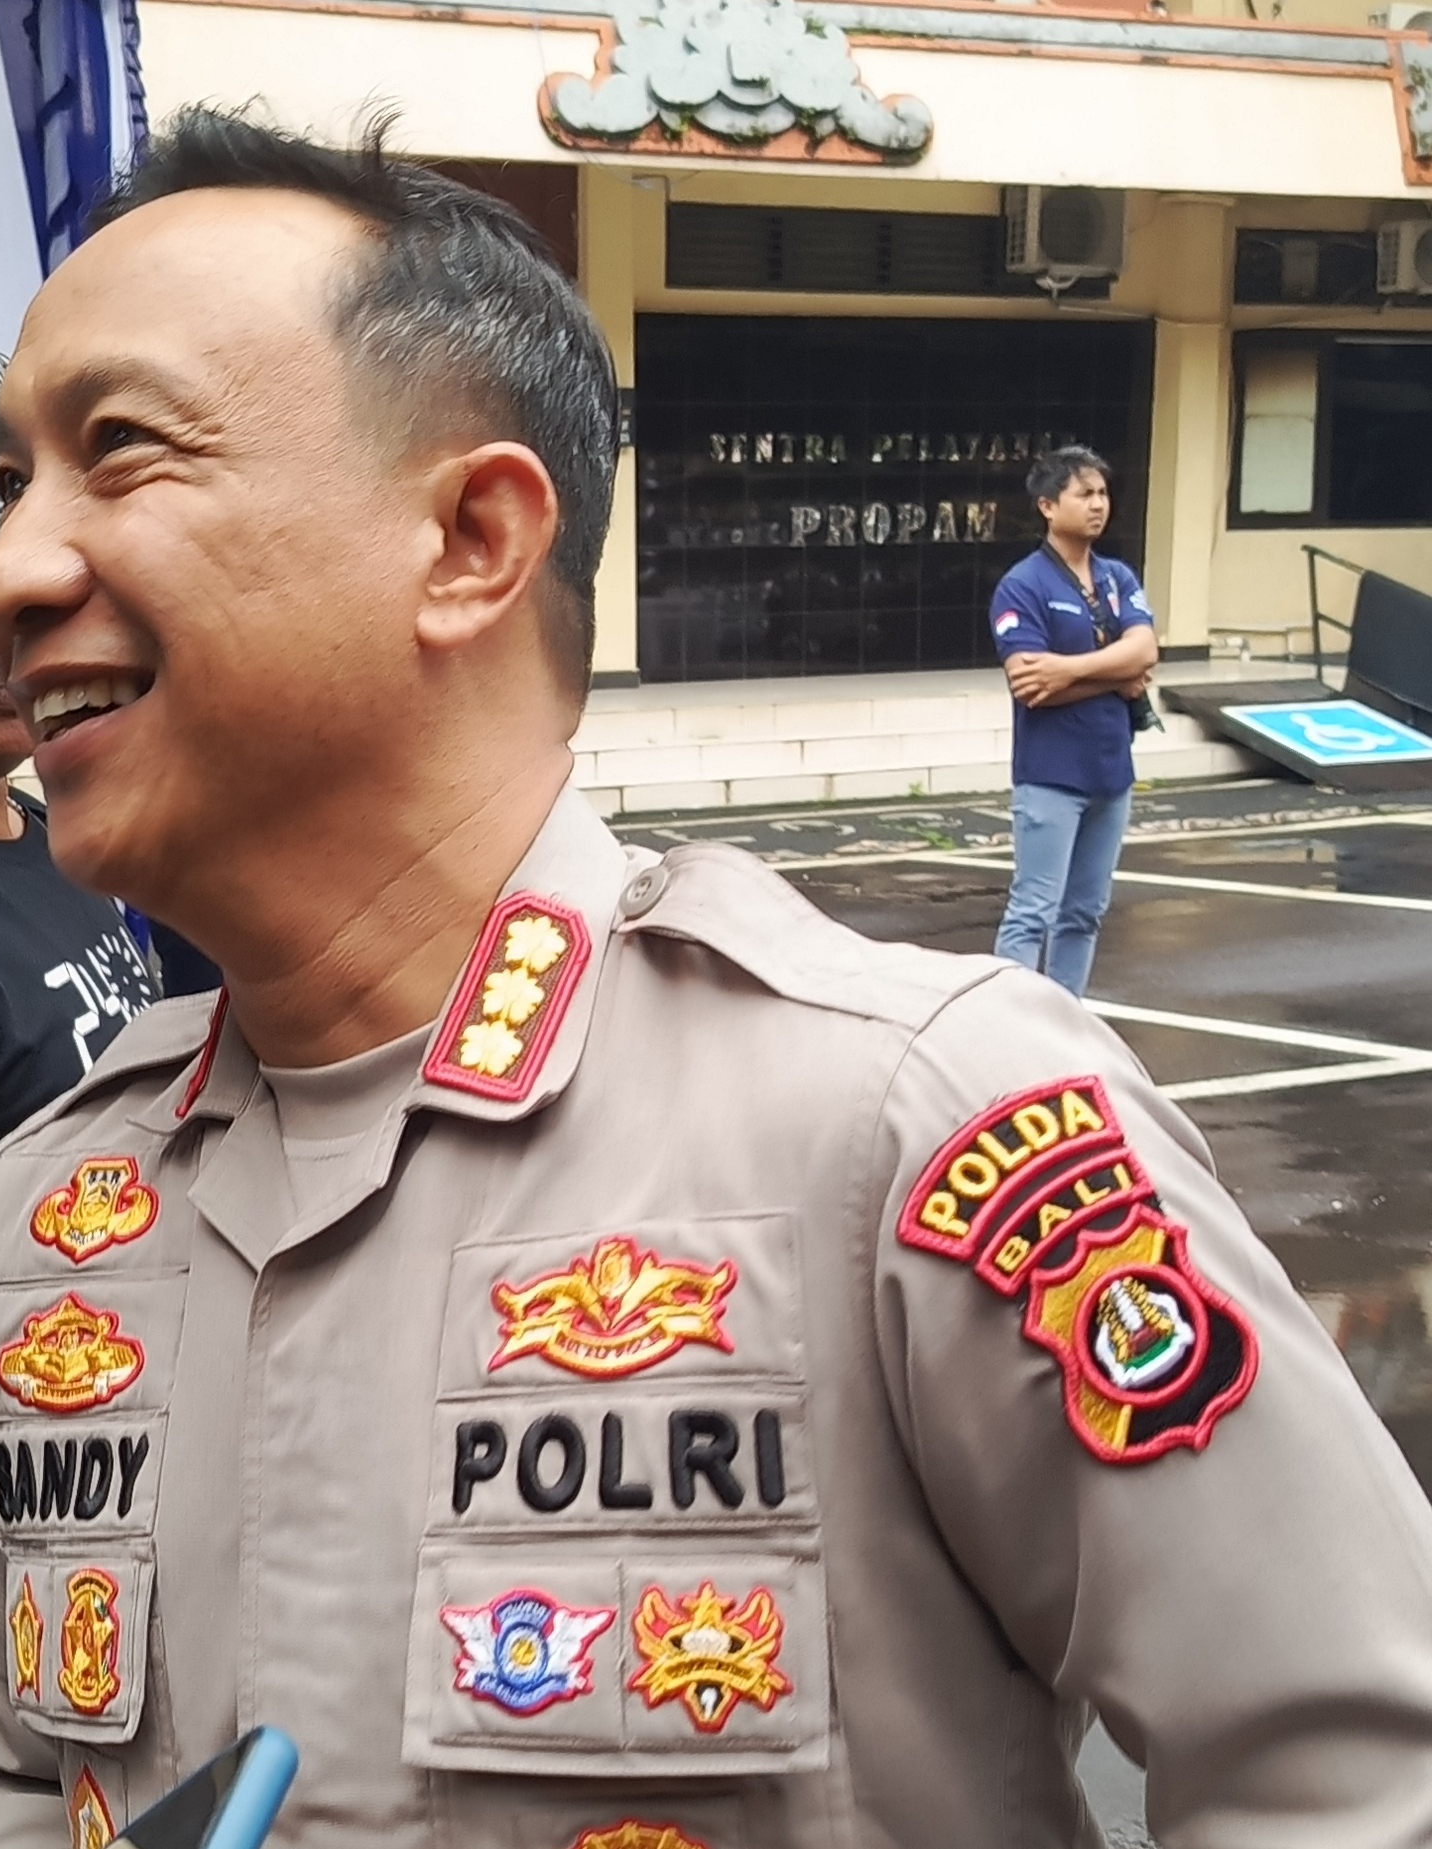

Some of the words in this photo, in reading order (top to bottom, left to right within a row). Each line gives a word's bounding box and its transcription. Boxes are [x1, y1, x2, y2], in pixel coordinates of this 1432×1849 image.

[710, 432, 847, 464] SENTRA
[871, 431, 1077, 464] PELAYANA
[788, 502, 998, 548] PROPAM
[920, 1089, 1106, 1238] POLDA
[993, 1164, 1135, 1273] BALI
[452, 1408, 786, 1514] POLRI
